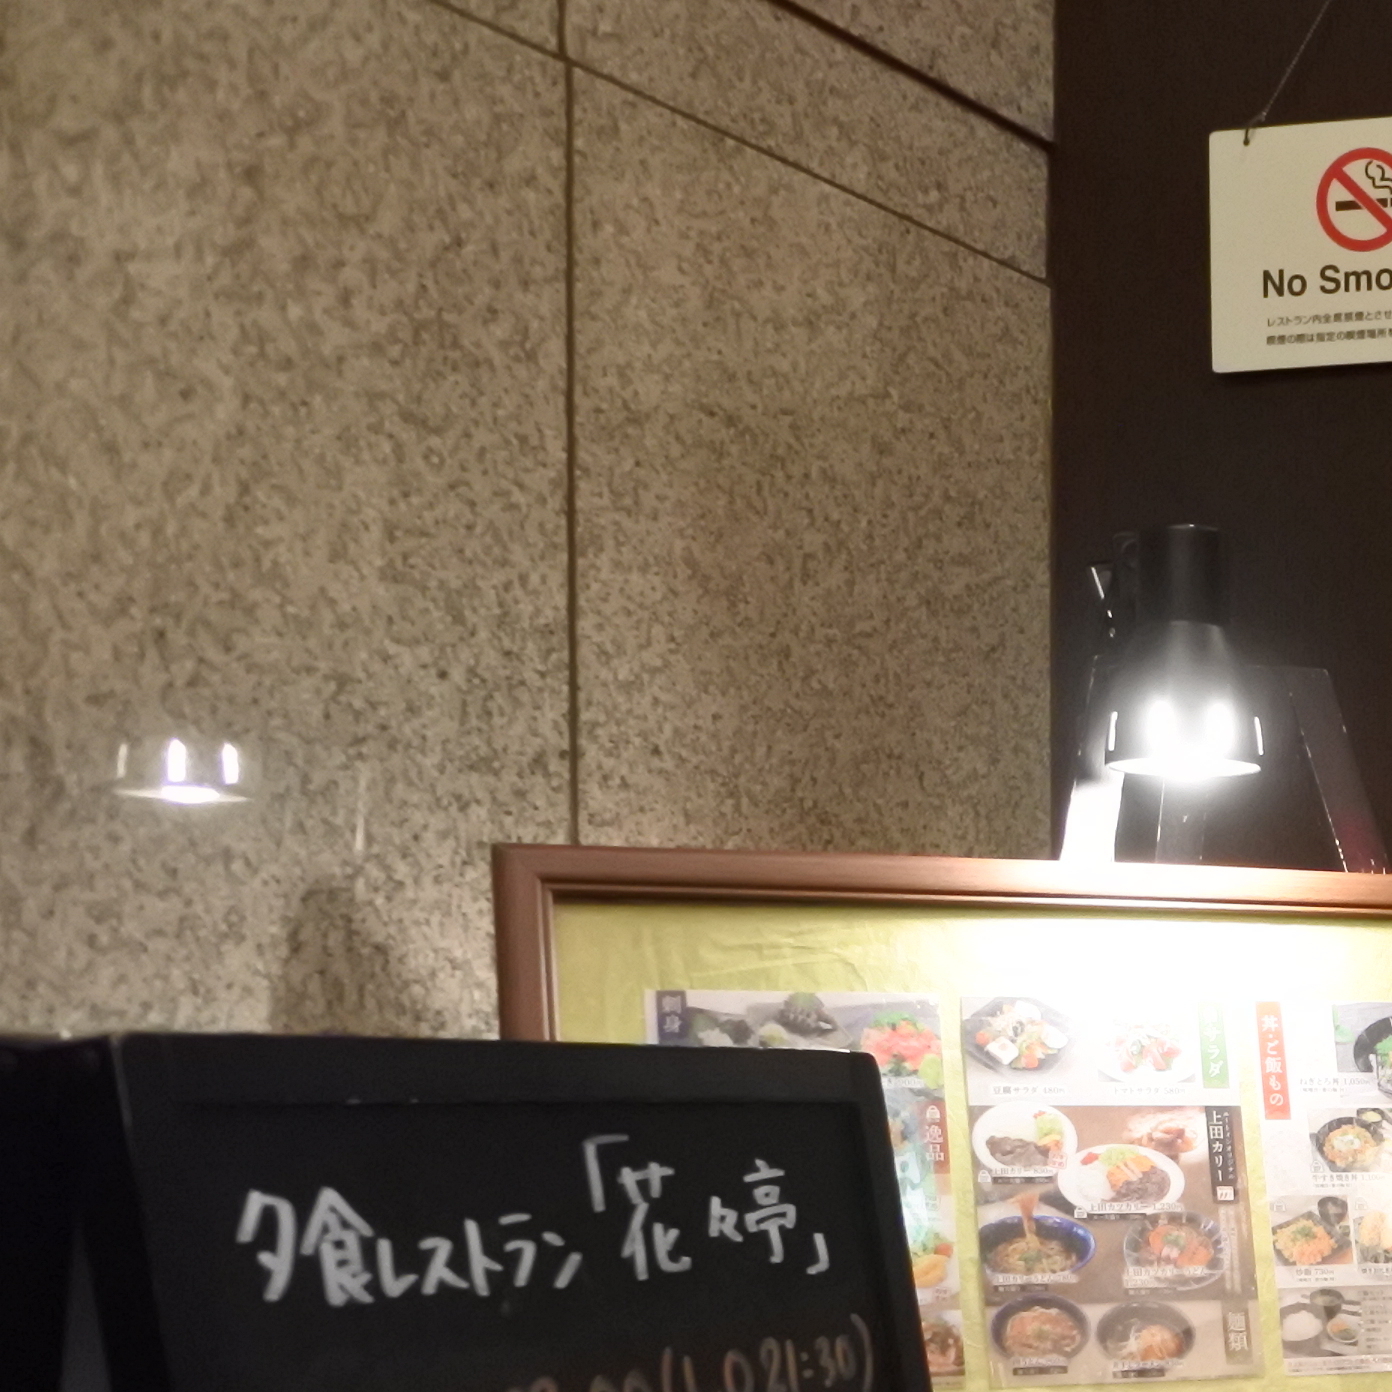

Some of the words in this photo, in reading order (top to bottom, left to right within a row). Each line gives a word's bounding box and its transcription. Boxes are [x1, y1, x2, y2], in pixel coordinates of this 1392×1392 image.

[1261, 268, 1308, 299] No
[1202, 1027, 1224, 1078] サラダ
[1261, 1014, 1284, 1106] 丼・ご飯もの
[993, 1086, 1039, 1095] 豆腐サラダ
[1113, 1086, 1161, 1095] トマトサラダ
[924, 1124, 945, 1162] 逸品
[1208, 1110, 1224, 1182] 上田カリー
